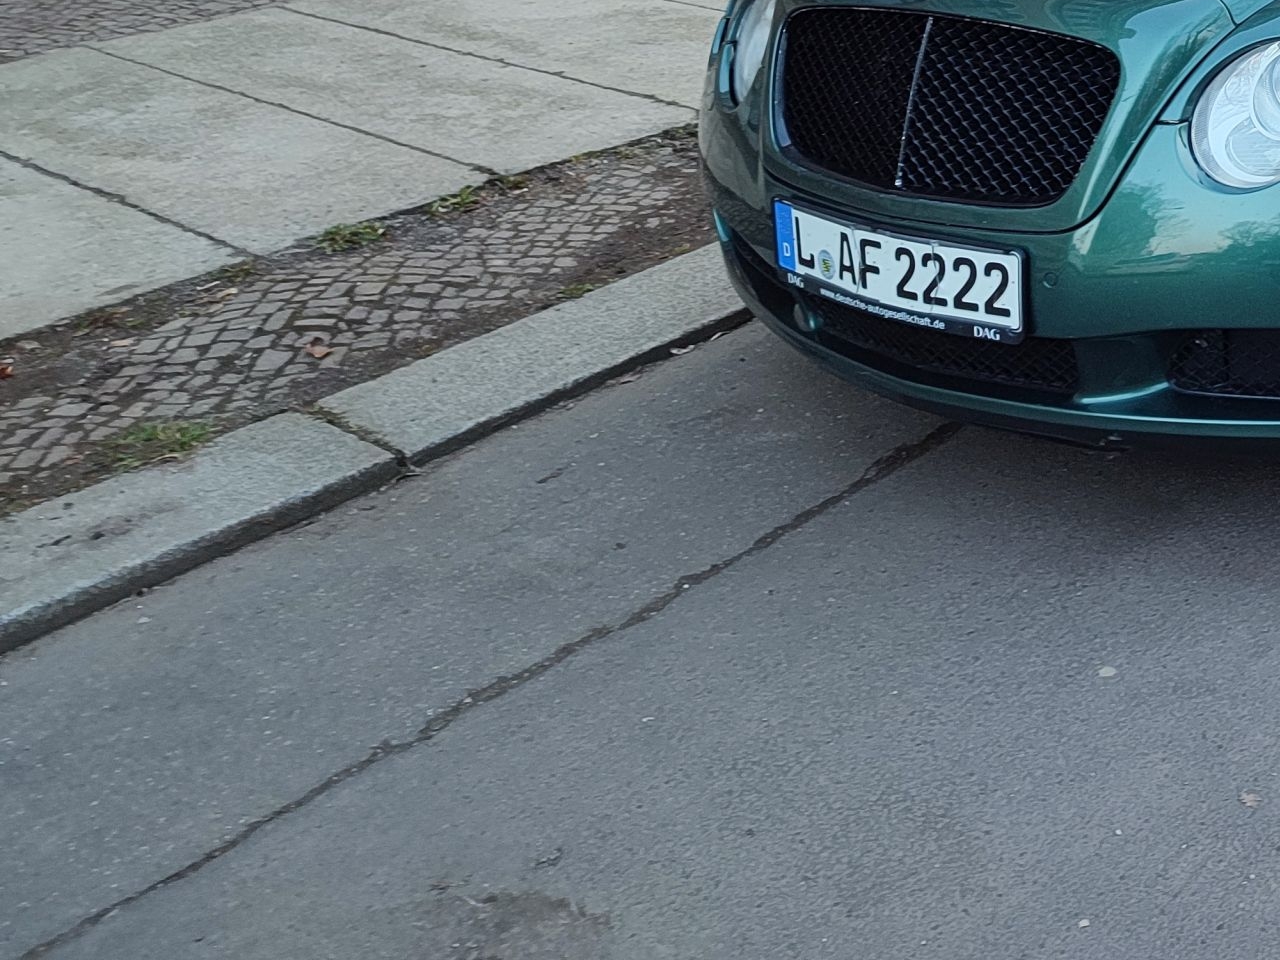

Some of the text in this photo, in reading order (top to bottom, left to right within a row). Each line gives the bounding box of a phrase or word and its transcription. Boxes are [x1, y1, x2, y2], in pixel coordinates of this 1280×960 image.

[783, 241, 792, 257] D
[794, 215, 1012, 319] L AF 2222
[973, 325, 1001, 341] DAG
